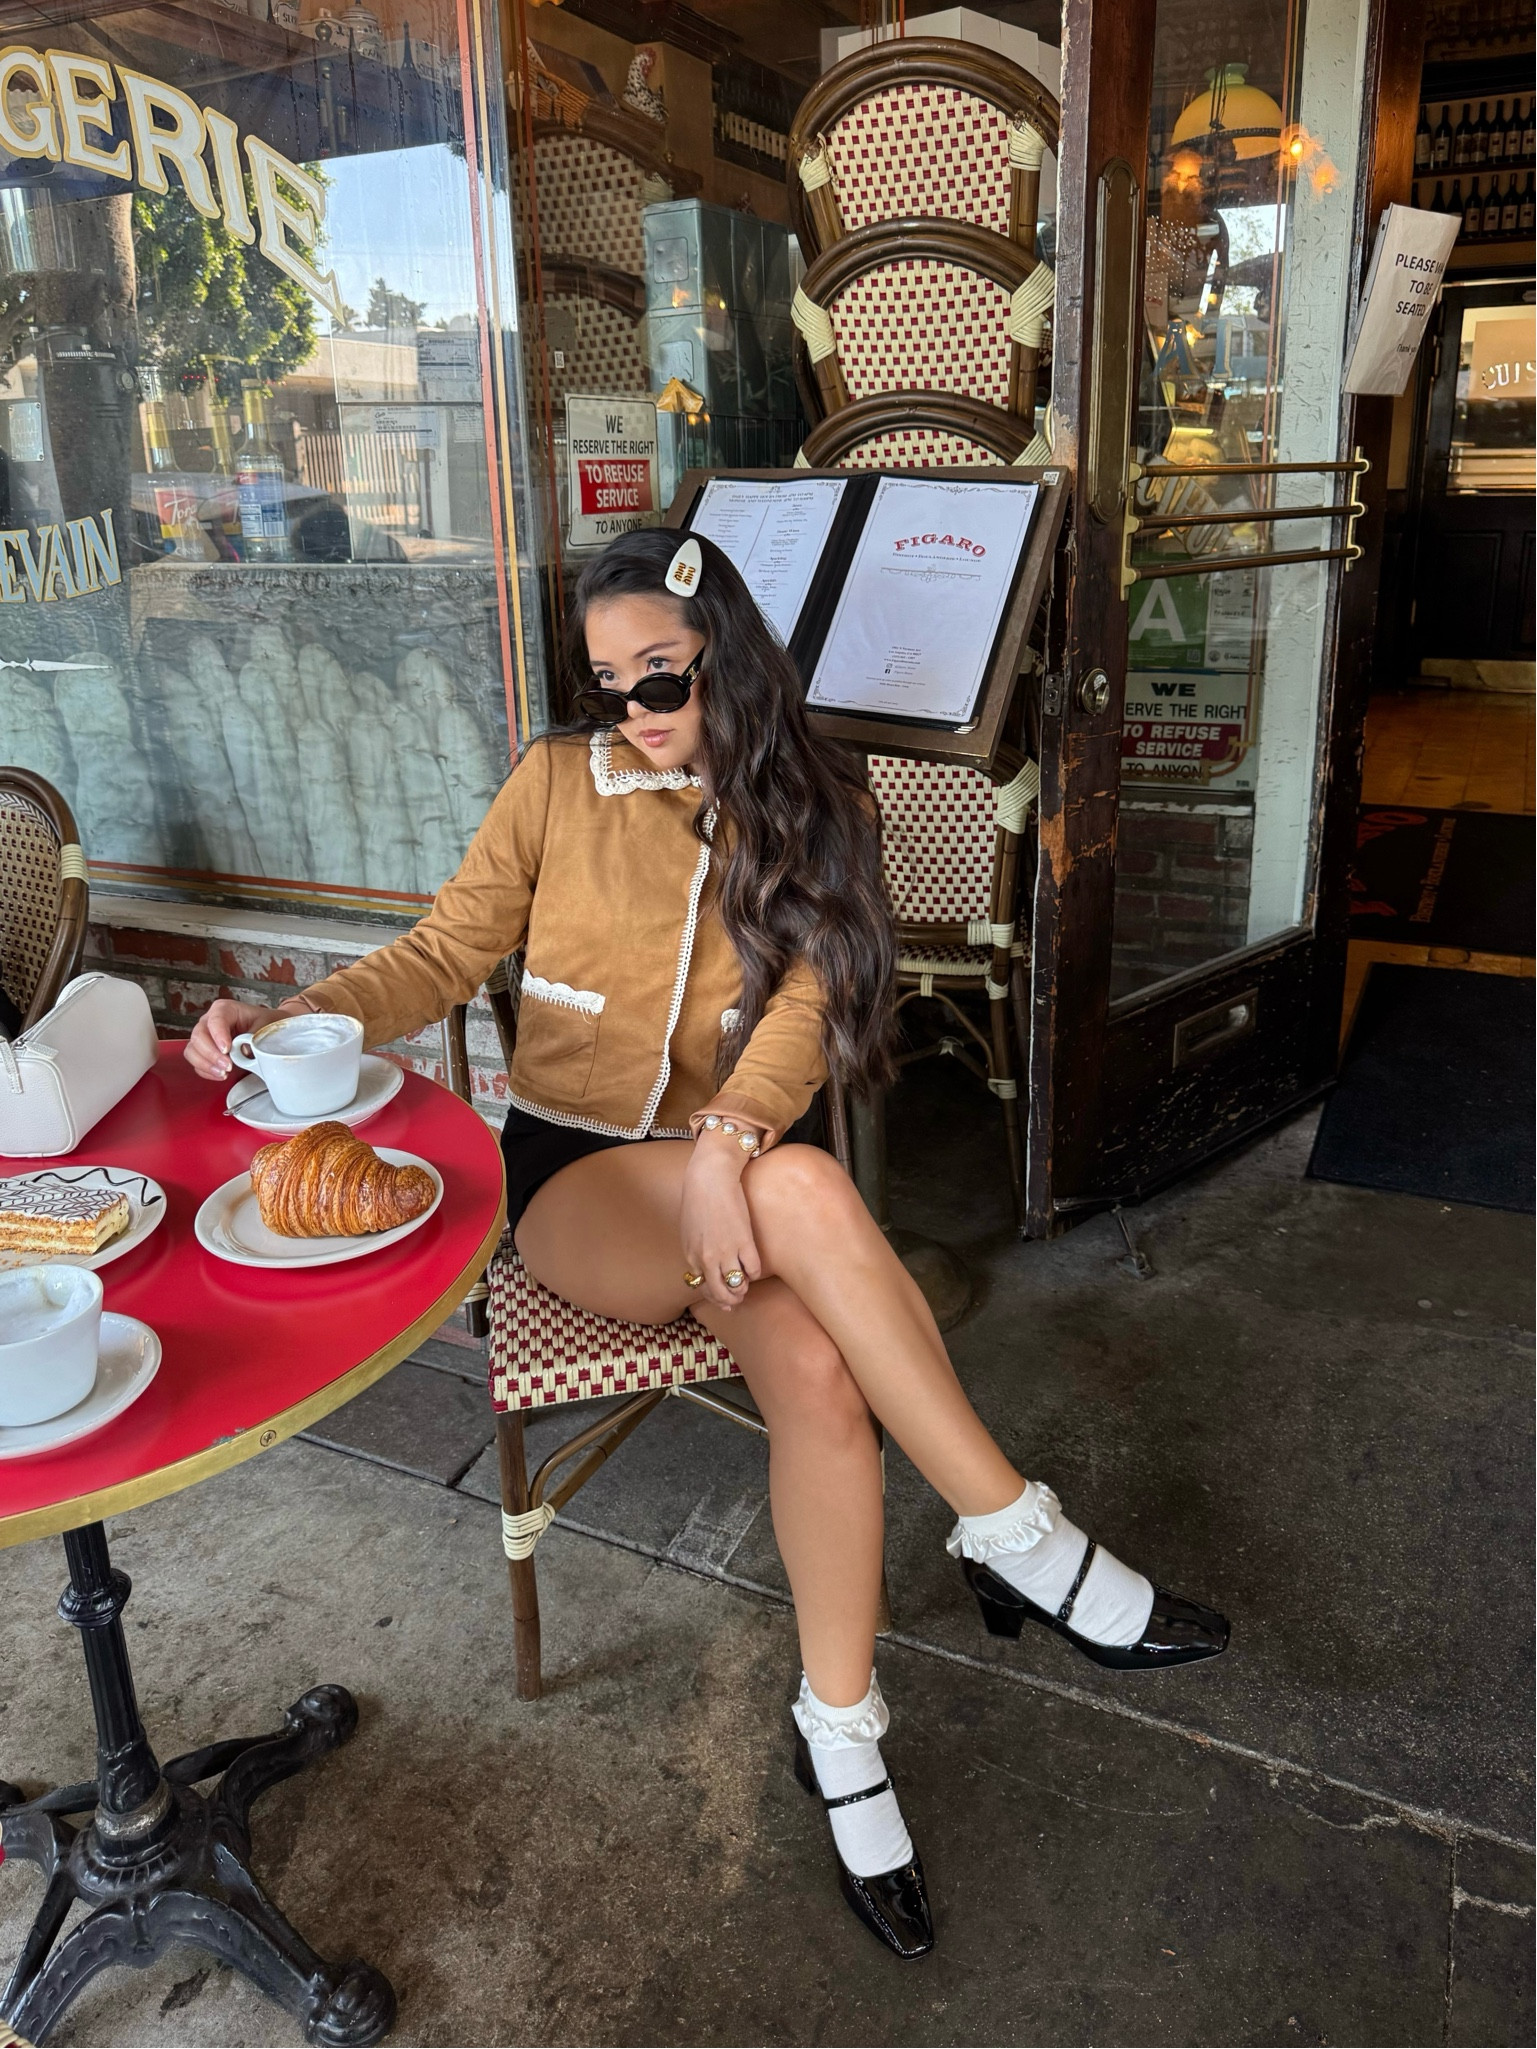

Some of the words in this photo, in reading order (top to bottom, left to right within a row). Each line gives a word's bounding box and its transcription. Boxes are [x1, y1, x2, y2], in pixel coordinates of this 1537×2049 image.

[0, 46, 346, 327] GERIE
[1395, 253, 1436, 274] PLEASE
[1409, 279, 1424, 294] TO
[1423, 282, 1434, 296] BE
[1395, 300, 1426, 317] SEATED
[605, 415, 624, 434] WE
[572, 439, 610, 455] RESERVE
[611, 440, 628, 455] THE
[629, 440, 655, 456] RIGHT
[585, 465, 601, 484] TO
[603, 464, 644, 483] REFUSE
[596, 487, 640, 508] SERVICE
[595, 520, 608, 535] TO
[893, 533, 986, 557] FIGARO
[0, 508, 122, 603] EVAIN
[1128, 578, 1187, 642] A
[1151, 682, 1196, 697] WE
[1125, 702, 1163, 717] ERVE
[1169, 703, 1198, 718] THE
[1204, 704, 1247, 720] RIGHT
[1122, 723, 1144, 738] TO
[1150, 725, 1222, 741] REFUSE
[1135, 741, 1204, 758] SERVICE
[1126, 762, 1145, 777] TO
[1153, 763, 1206, 780] ANYON
